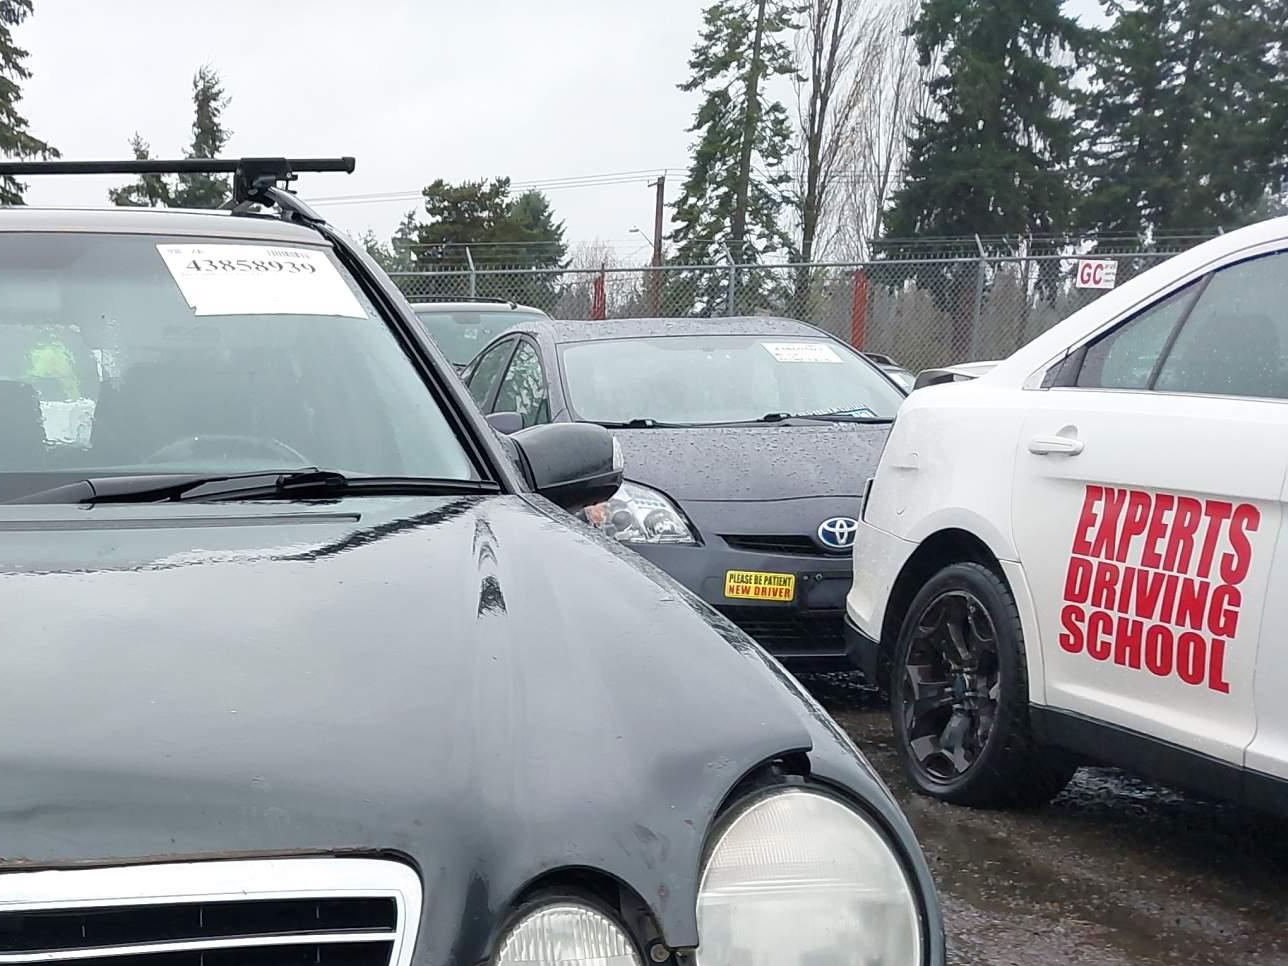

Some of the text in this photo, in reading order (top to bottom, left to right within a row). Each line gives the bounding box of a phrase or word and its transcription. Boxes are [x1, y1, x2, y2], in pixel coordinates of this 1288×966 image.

[187, 259, 316, 273] 43858939
[1080, 263, 1104, 285] GC
[1072, 484, 1261, 585] EXPERTS
[729, 573, 792, 586] PLEASE BE PATIENT
[728, 584, 791, 598] NEW DRIVER
[1063, 556, 1242, 639] DRIVING
[1059, 604, 1230, 694] SCHOOL
